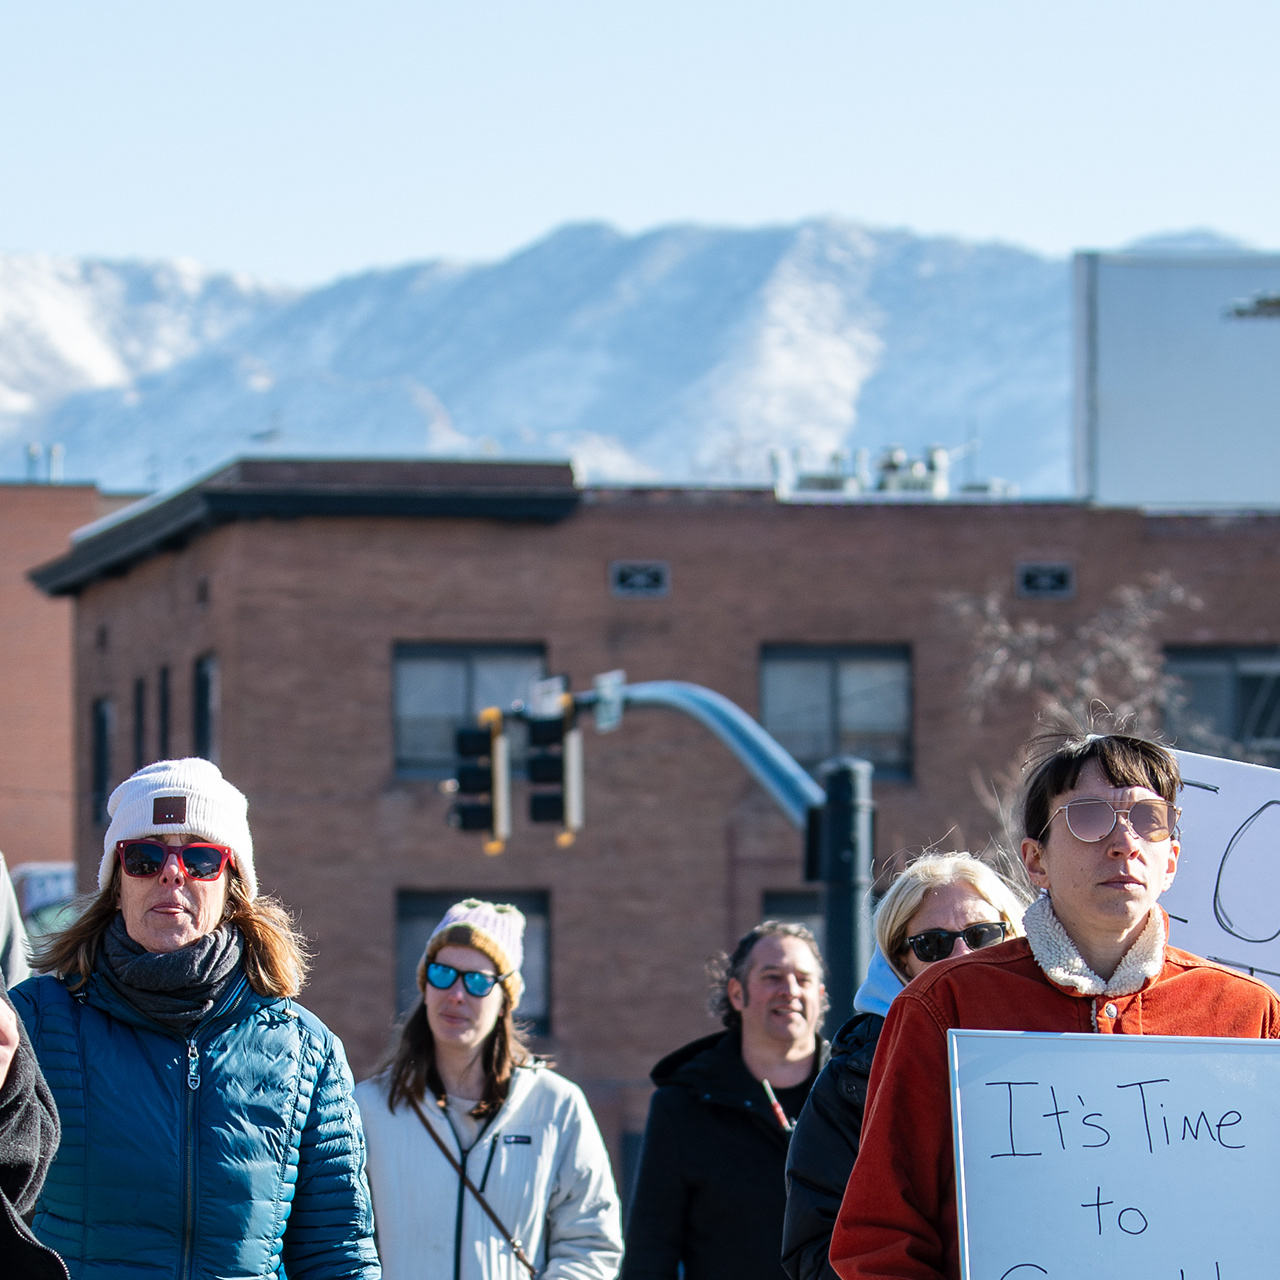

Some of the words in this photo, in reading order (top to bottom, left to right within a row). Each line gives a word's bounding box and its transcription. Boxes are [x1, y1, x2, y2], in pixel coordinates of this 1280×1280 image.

[986, 1082, 1110, 1158] It's
[1117, 1079, 1245, 1153] Time
[1081, 1186, 1148, 1235] to
